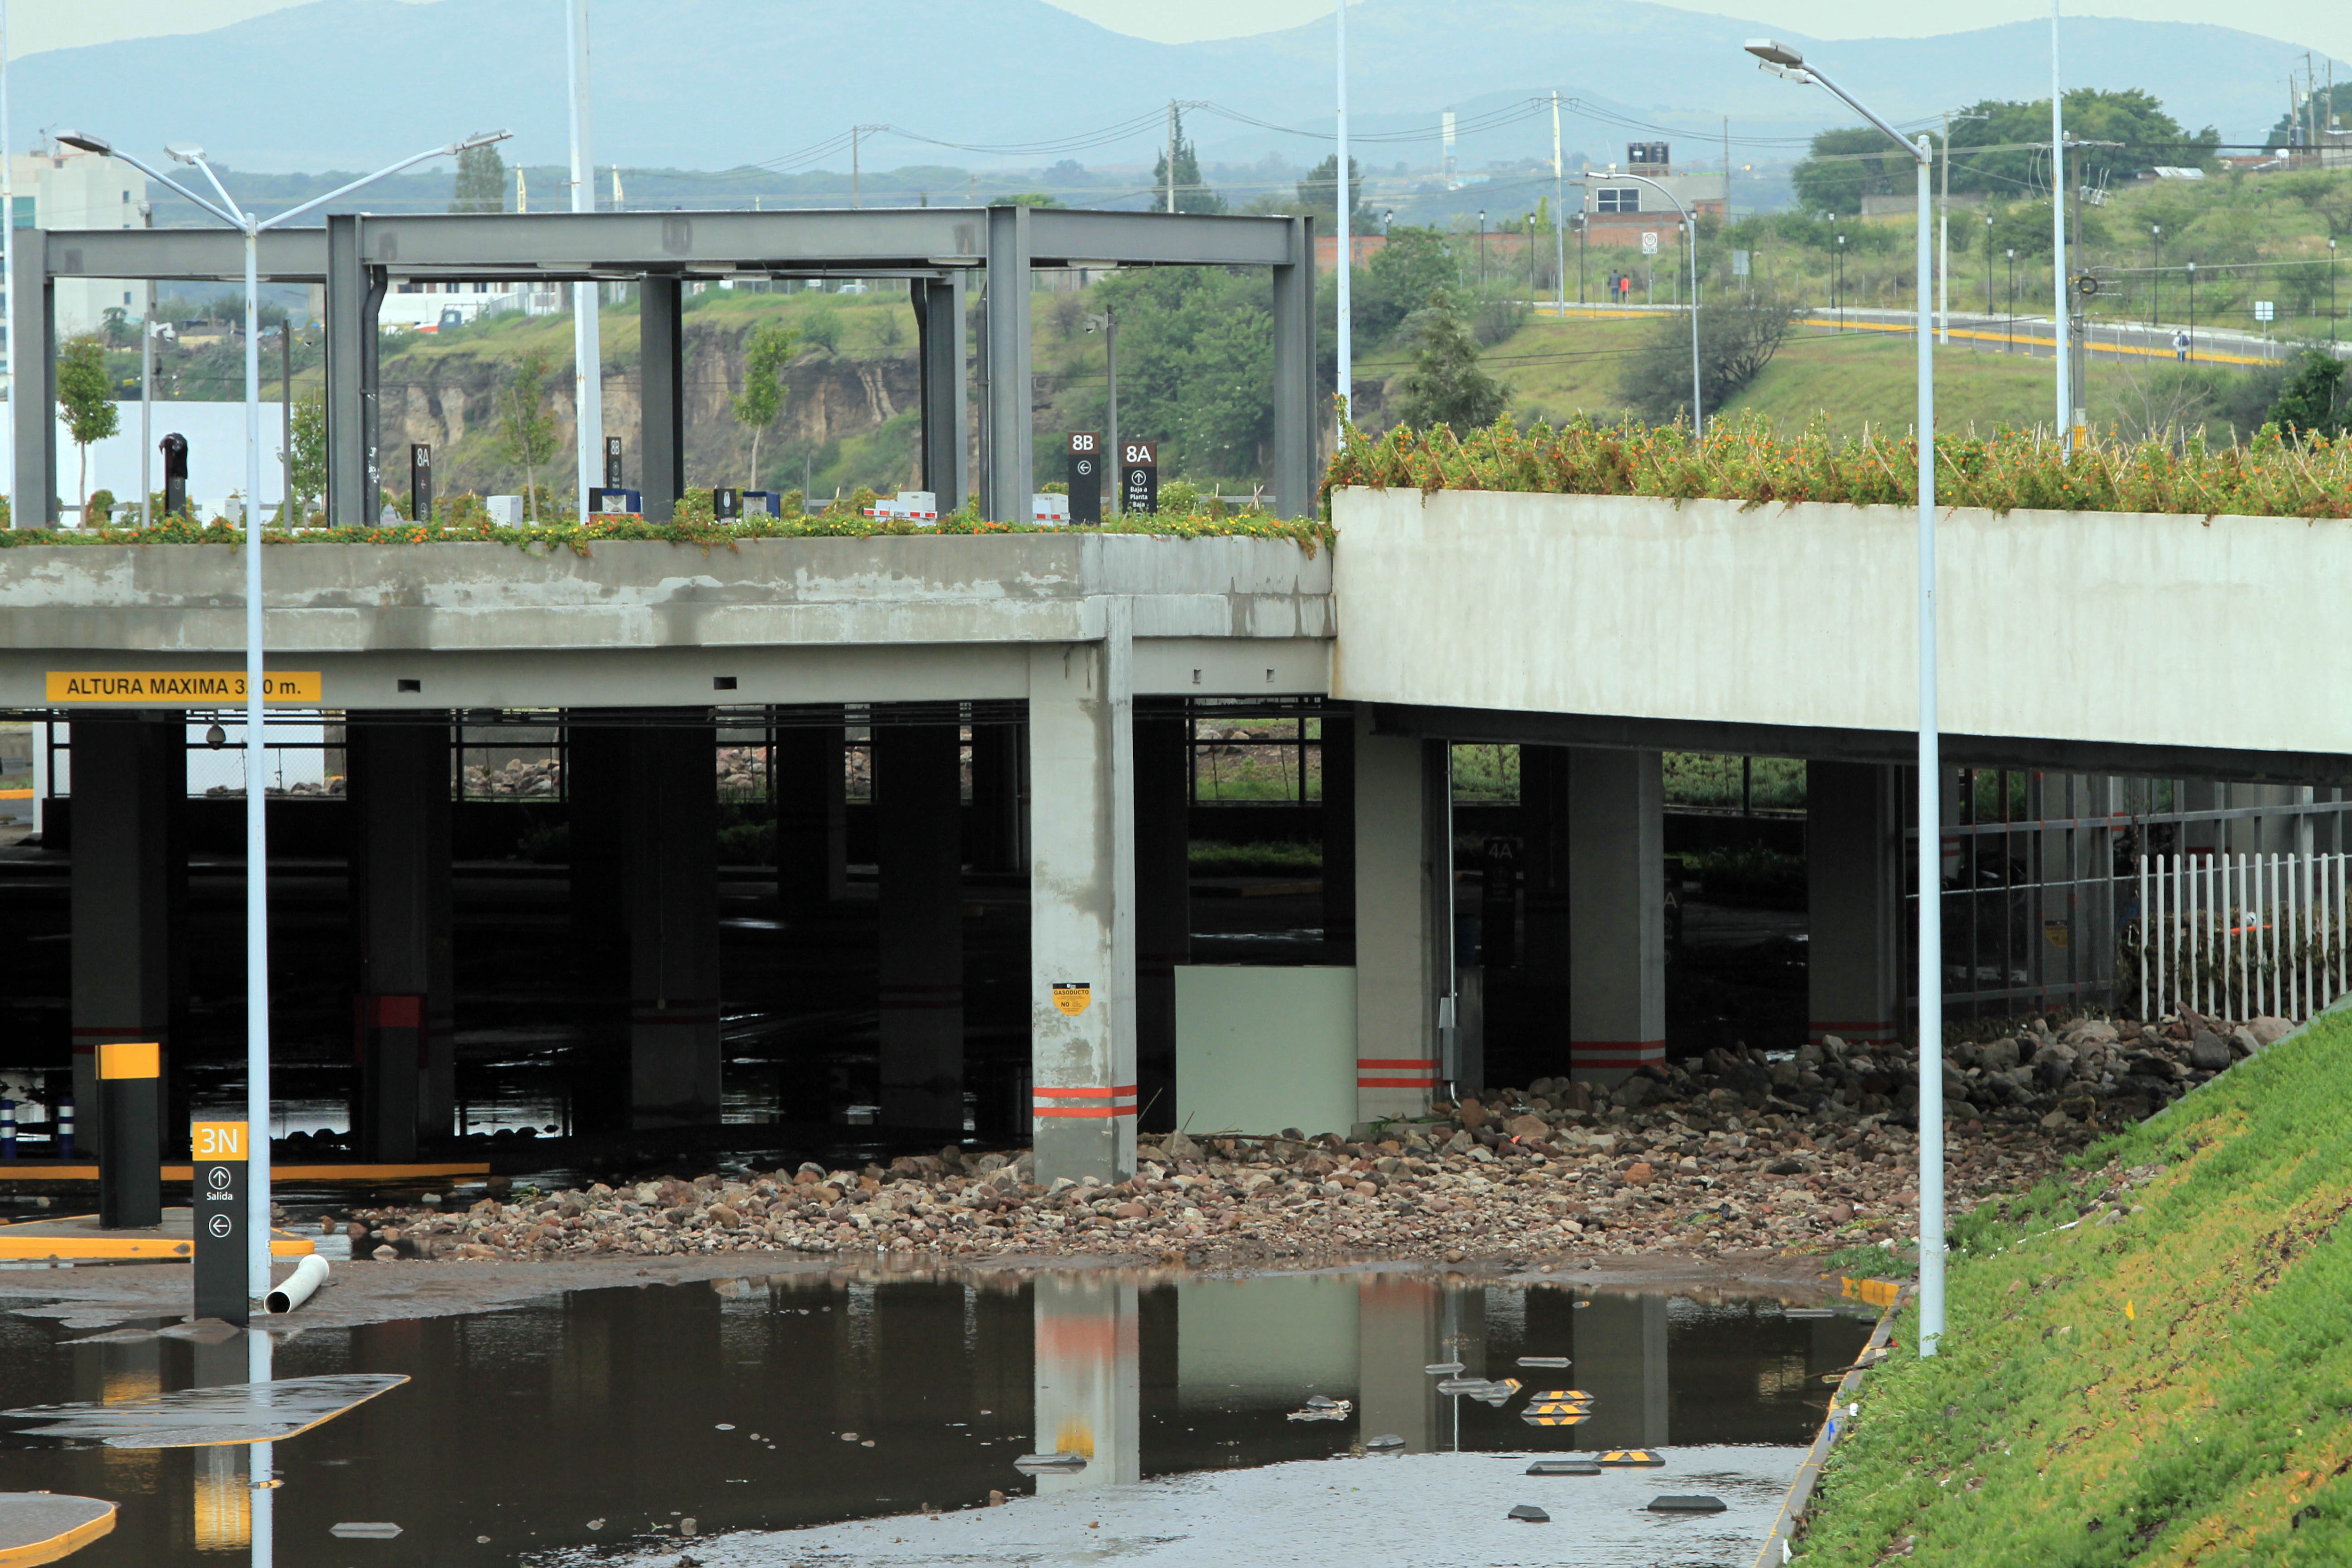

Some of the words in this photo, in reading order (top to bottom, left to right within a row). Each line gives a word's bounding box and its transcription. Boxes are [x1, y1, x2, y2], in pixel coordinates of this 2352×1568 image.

[1073, 435, 1094, 450] 8B
[417, 448, 429, 467] 8A
[1126, 446, 1152, 462] 8A
[67, 678, 143, 694] ALTURA
[150, 678, 229, 694] MAXIMA
[235, 678, 273, 694] 3.0
[280, 681, 301, 694] m.
[1489, 843, 1513, 859] 4A
[1664, 891, 1677, 908] A
[201, 1128, 238, 1154] 3N
[207, 1192, 233, 1201] Salida
